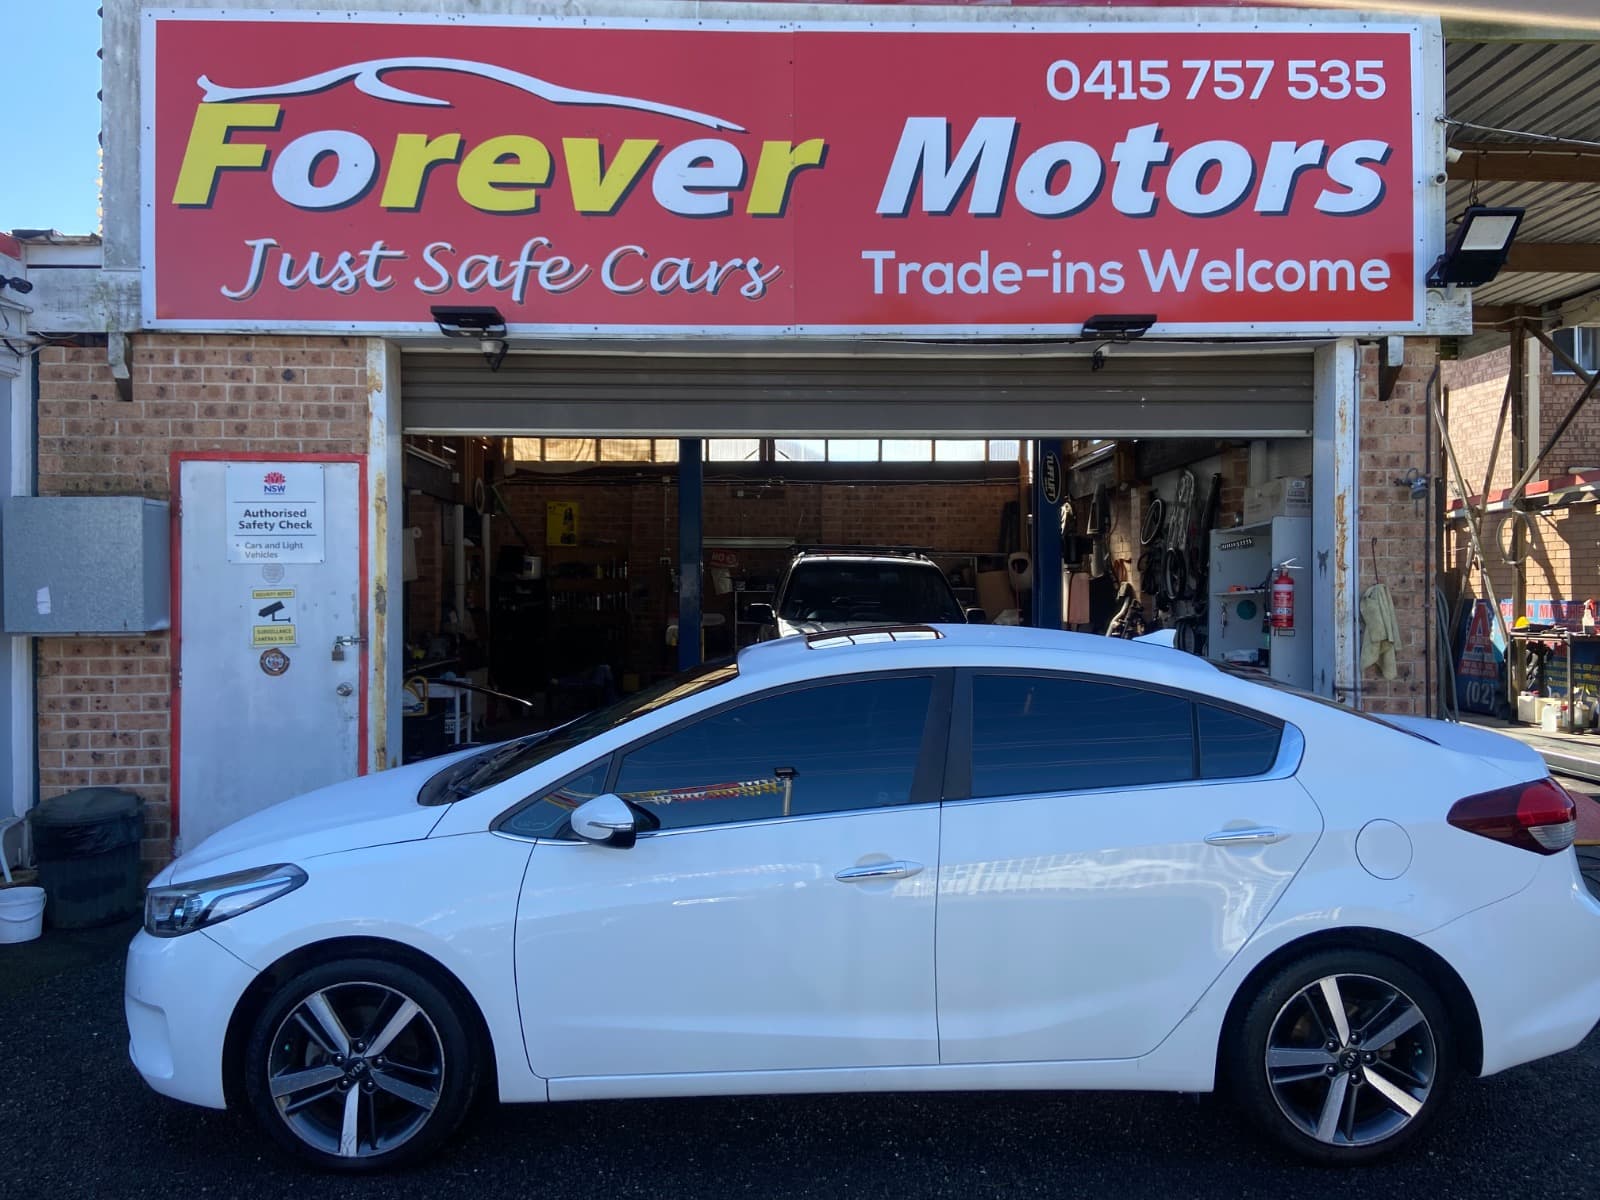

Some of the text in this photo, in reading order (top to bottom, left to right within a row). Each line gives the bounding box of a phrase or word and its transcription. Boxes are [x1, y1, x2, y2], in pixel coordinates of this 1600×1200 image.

[1047, 59, 1386, 101] 0415 757 535
[172, 102, 1391, 217] Forever Motors
[221, 236, 781, 303] Just Safe Cars
[862, 248, 1390, 295] Trade-ins Welcome
[263, 485, 287, 494] NSW
[243, 508, 307, 519] Authorised
[238, 520, 313, 532] Safety Check
[244, 541, 304, 551] Cars and Light
[244, 551, 279, 559] Vehicles
[1466, 681, 1496, 711] (02)
